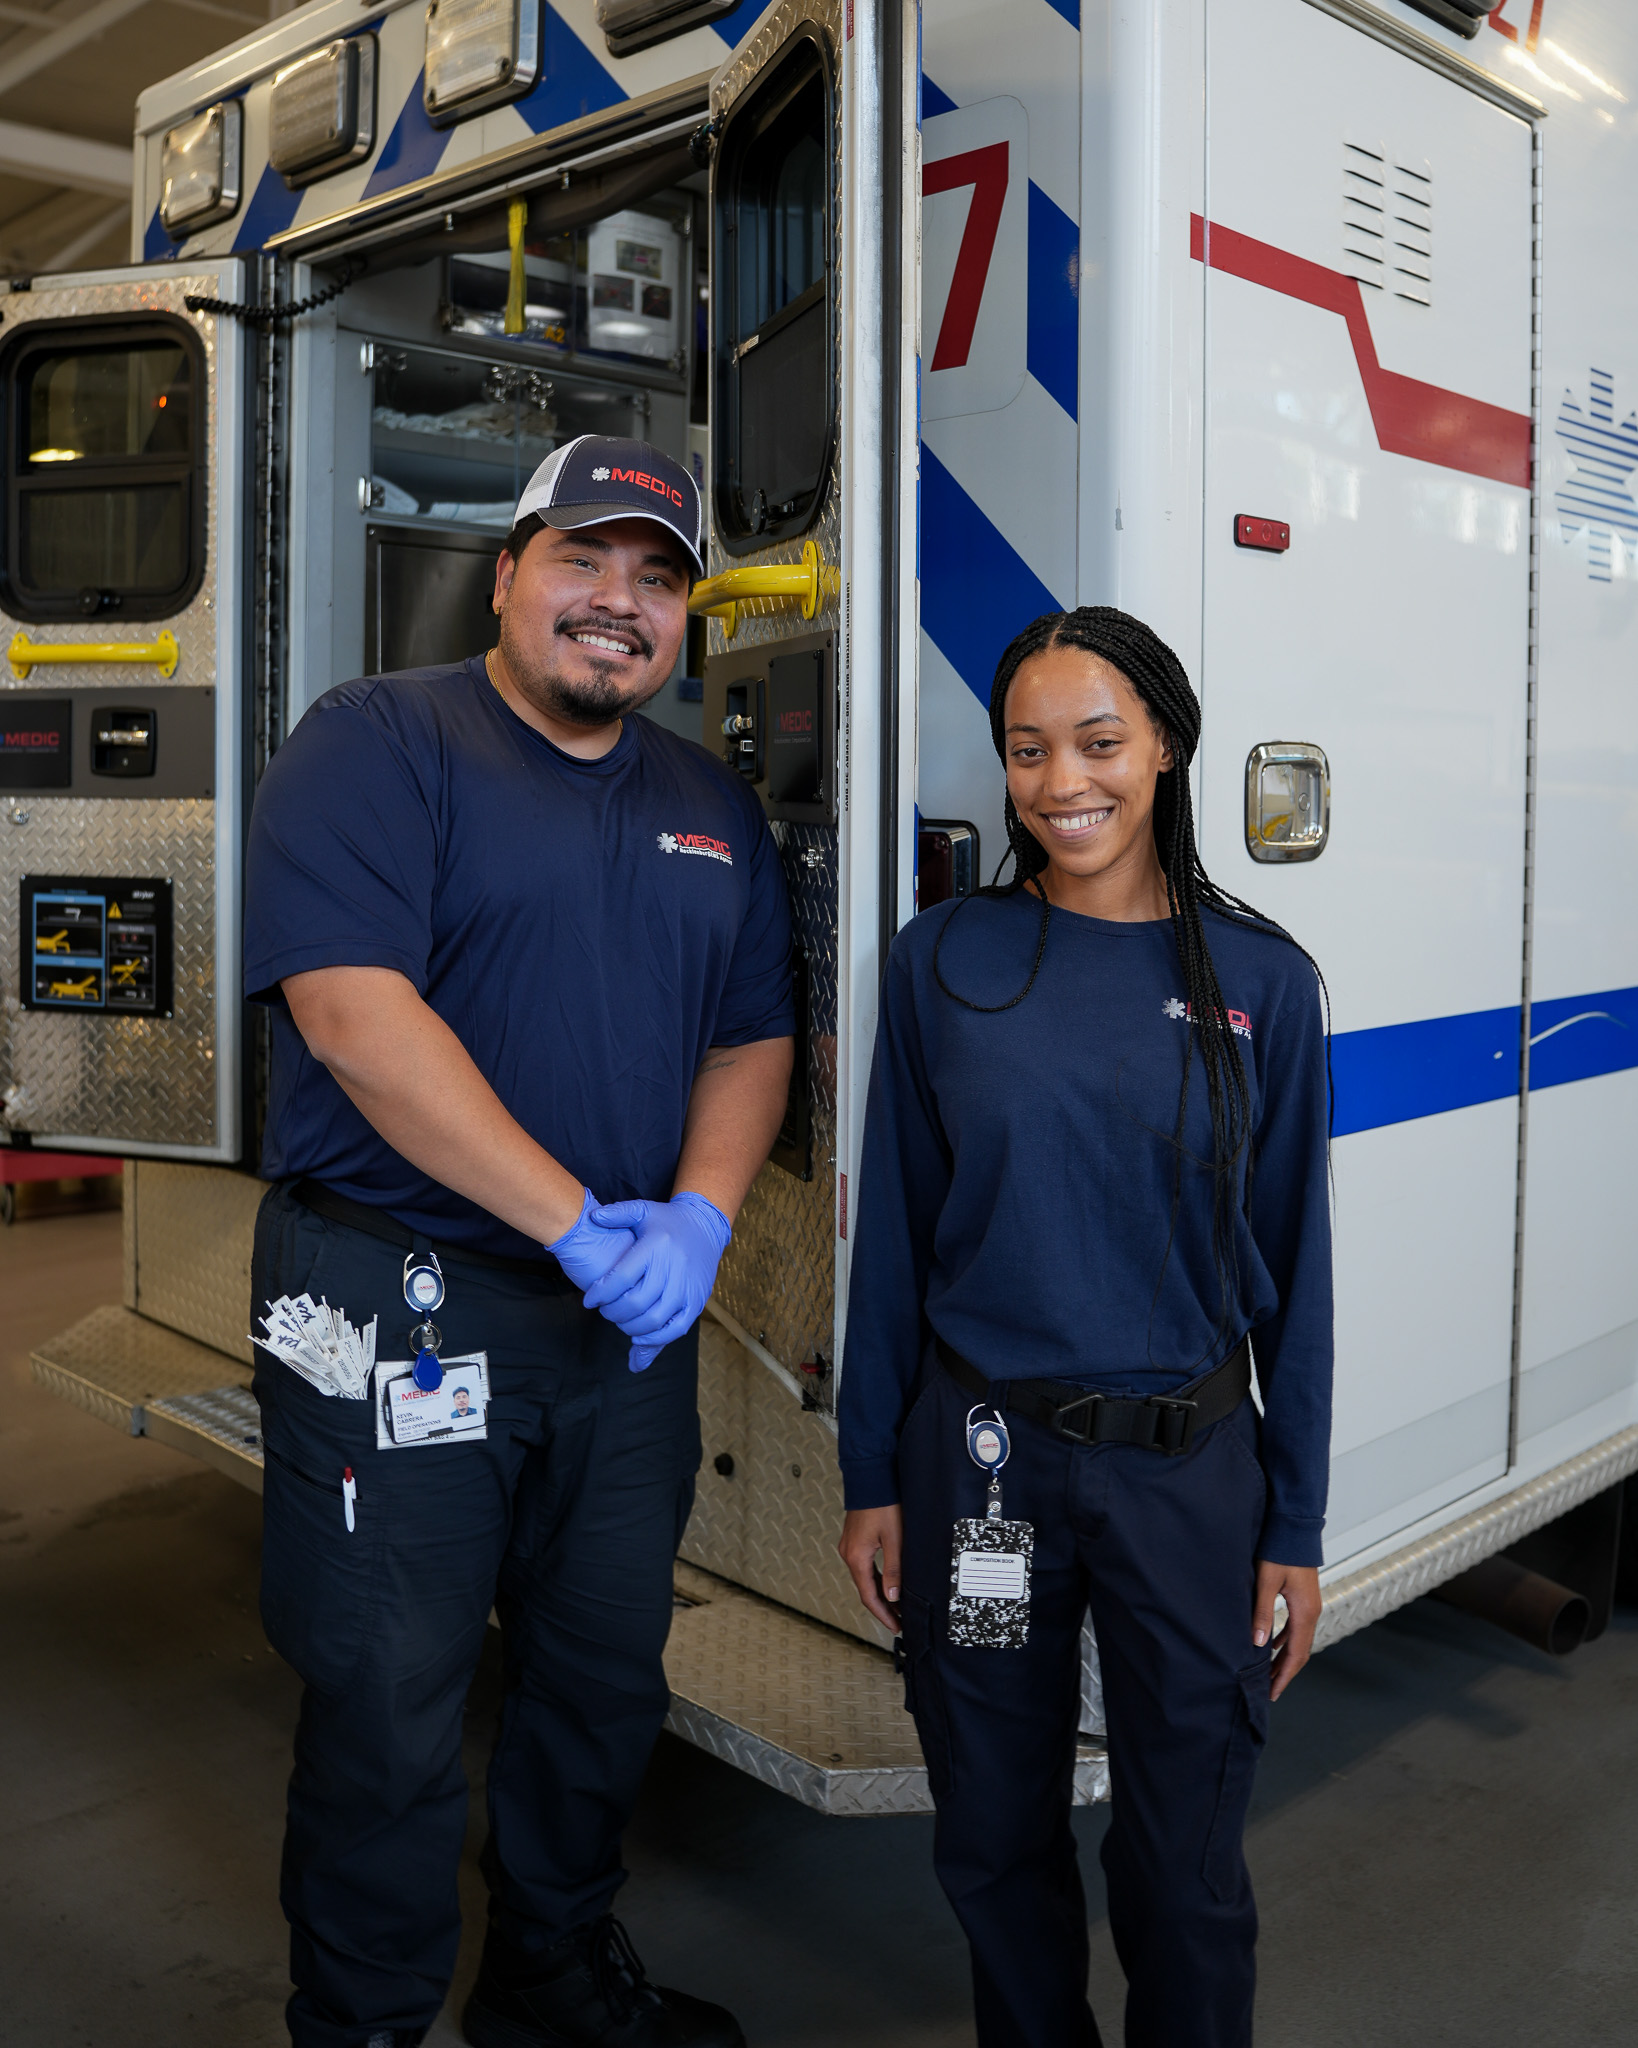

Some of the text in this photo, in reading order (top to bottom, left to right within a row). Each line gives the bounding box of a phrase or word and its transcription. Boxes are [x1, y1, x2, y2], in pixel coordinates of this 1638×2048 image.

[922, 140, 1009, 372] 7
[611, 467, 683, 508] MEDIC
[780, 710, 812, 732] MEDIC
[5, 731, 60, 747] MEDIC
[676, 833, 731, 856] MEDIC
[401, 1386, 440, 1402] MEDIC
